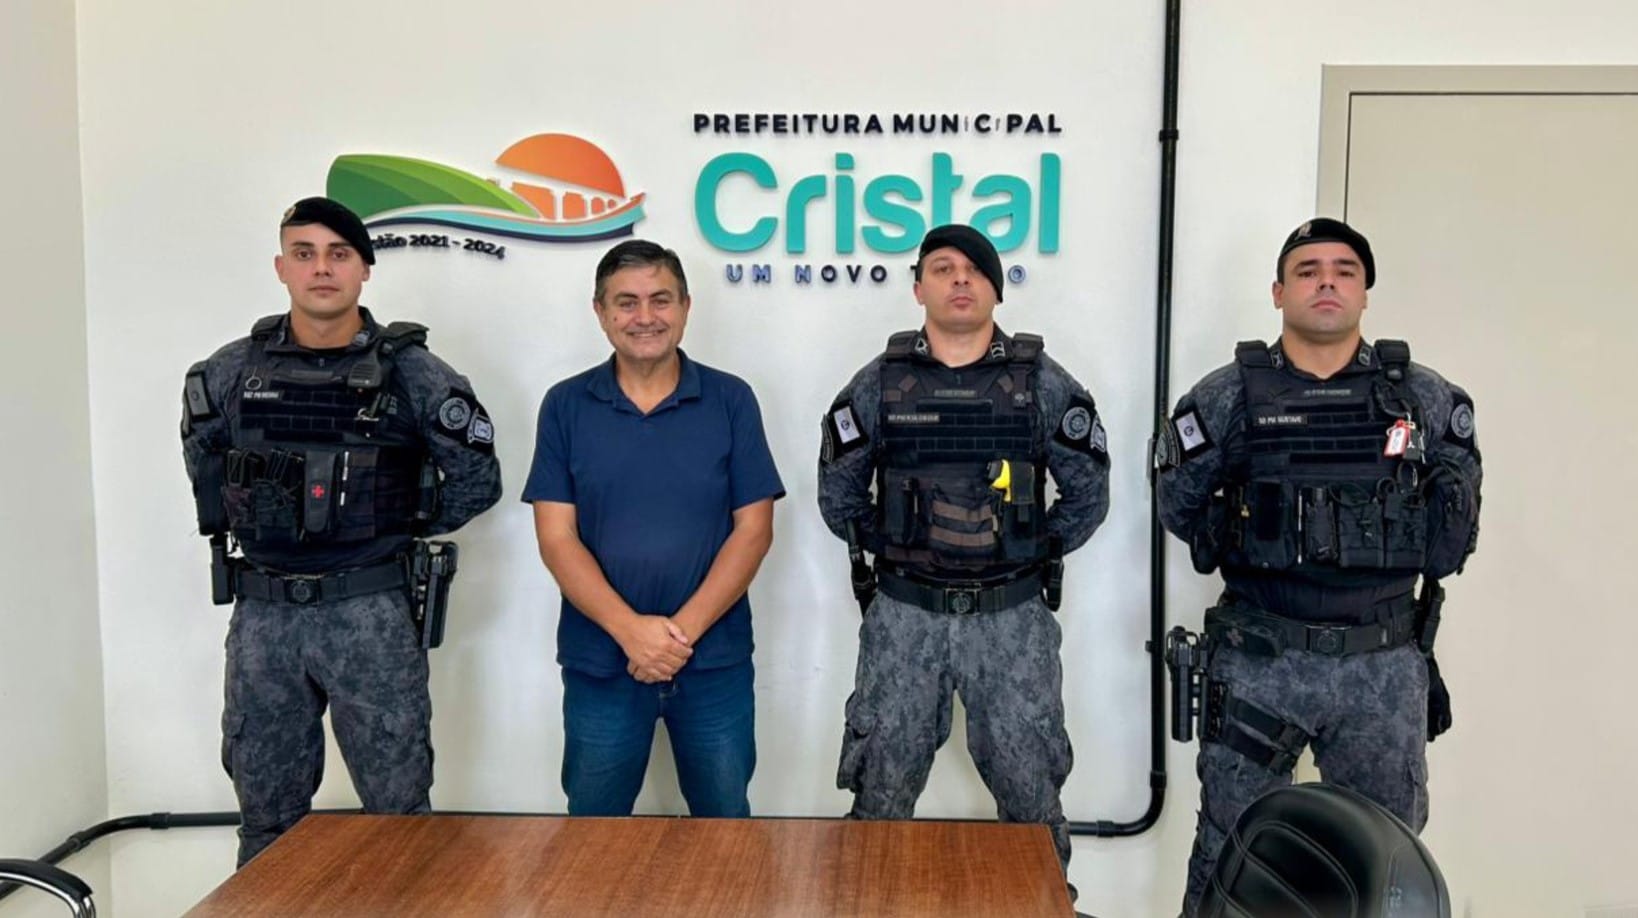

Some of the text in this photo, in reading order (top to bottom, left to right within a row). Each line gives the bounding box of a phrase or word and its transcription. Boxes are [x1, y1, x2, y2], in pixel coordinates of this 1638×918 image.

[694, 113, 883, 134] PREFEITURA
[694, 152, 1062, 255] Cristal
[409, 234, 451, 249] 2021
[463, 238, 506, 260] 2024
[725, 264, 772, 283] UM
[795, 264, 889, 284] NOVO
